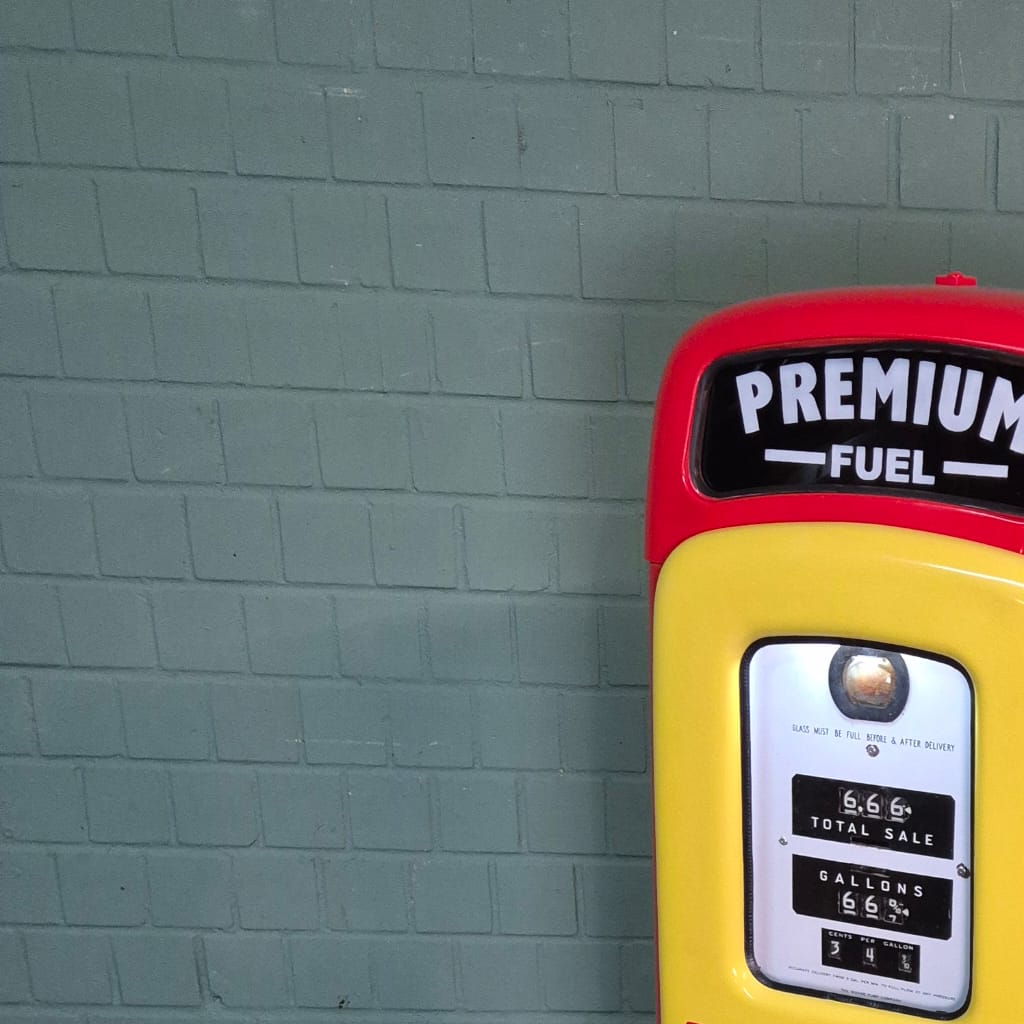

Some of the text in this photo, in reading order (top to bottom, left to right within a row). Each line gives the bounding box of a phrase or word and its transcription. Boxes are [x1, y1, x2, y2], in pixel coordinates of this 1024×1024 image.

[830, 443, 935, 486] FUEL
[792, 723, 955, 752] GLASS MUST BE FULL BEFORE & AFTER DELIVERY
[810, 816, 934, 846] TOTAL SALE
[819, 870, 923, 897] GALLONS
[828, 931, 852, 940] CENTS
[883, 941, 914, 950] GALLON
